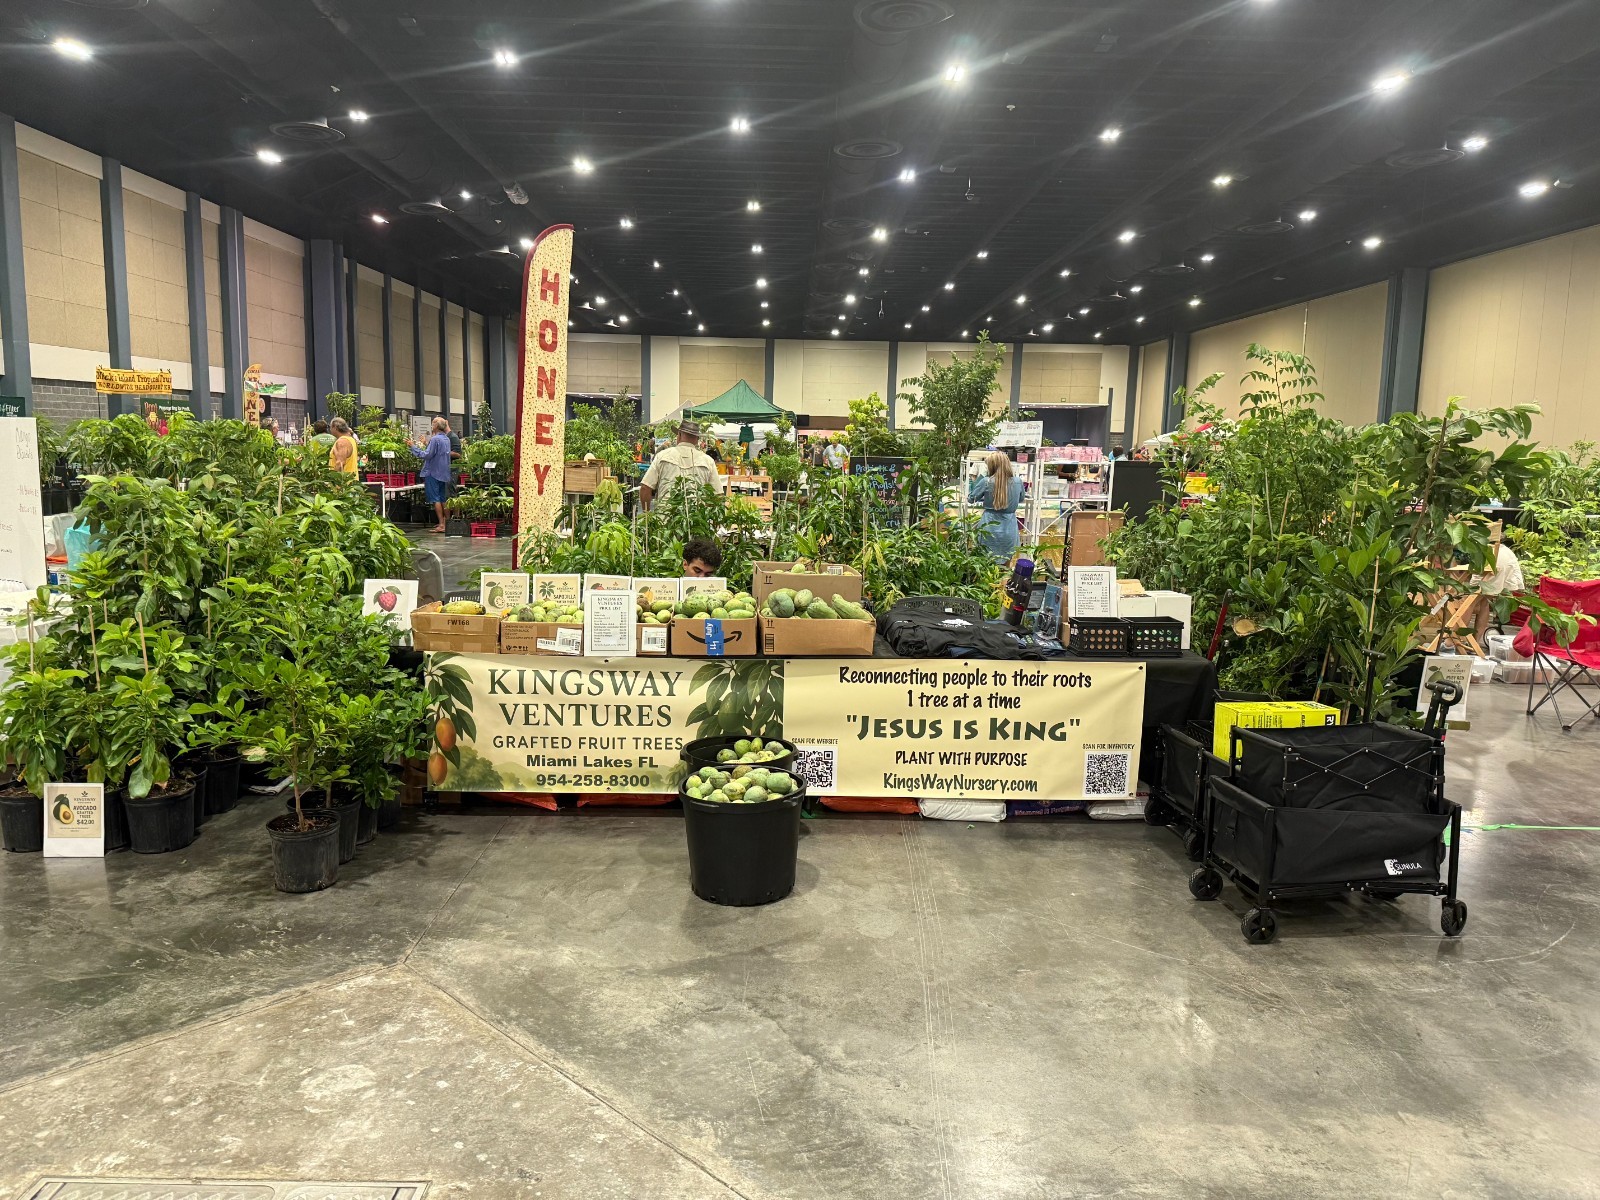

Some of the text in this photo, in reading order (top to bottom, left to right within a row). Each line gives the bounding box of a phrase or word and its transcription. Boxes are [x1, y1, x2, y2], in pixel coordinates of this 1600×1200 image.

[534, 267, 560, 496] HONEY
[487, 668, 684, 697] KINGSWAY
[839, 666, 1092, 690] Reconnecting people to their roots
[907, 689, 1022, 710] 1 tree at a time
[498, 703, 673, 728] VENTURES
[953, 719, 979, 741] IS
[492, 735, 684, 751] GRAFTED FRUIT TREES
[526, 754, 659, 769] Miami Lakes FL
[895, 750, 1028, 767] PLANT WITH PURPOSE
[536, 773, 650, 788] 954-258-8300
[883, 772, 1038, 794] KingsWayNursery.com
